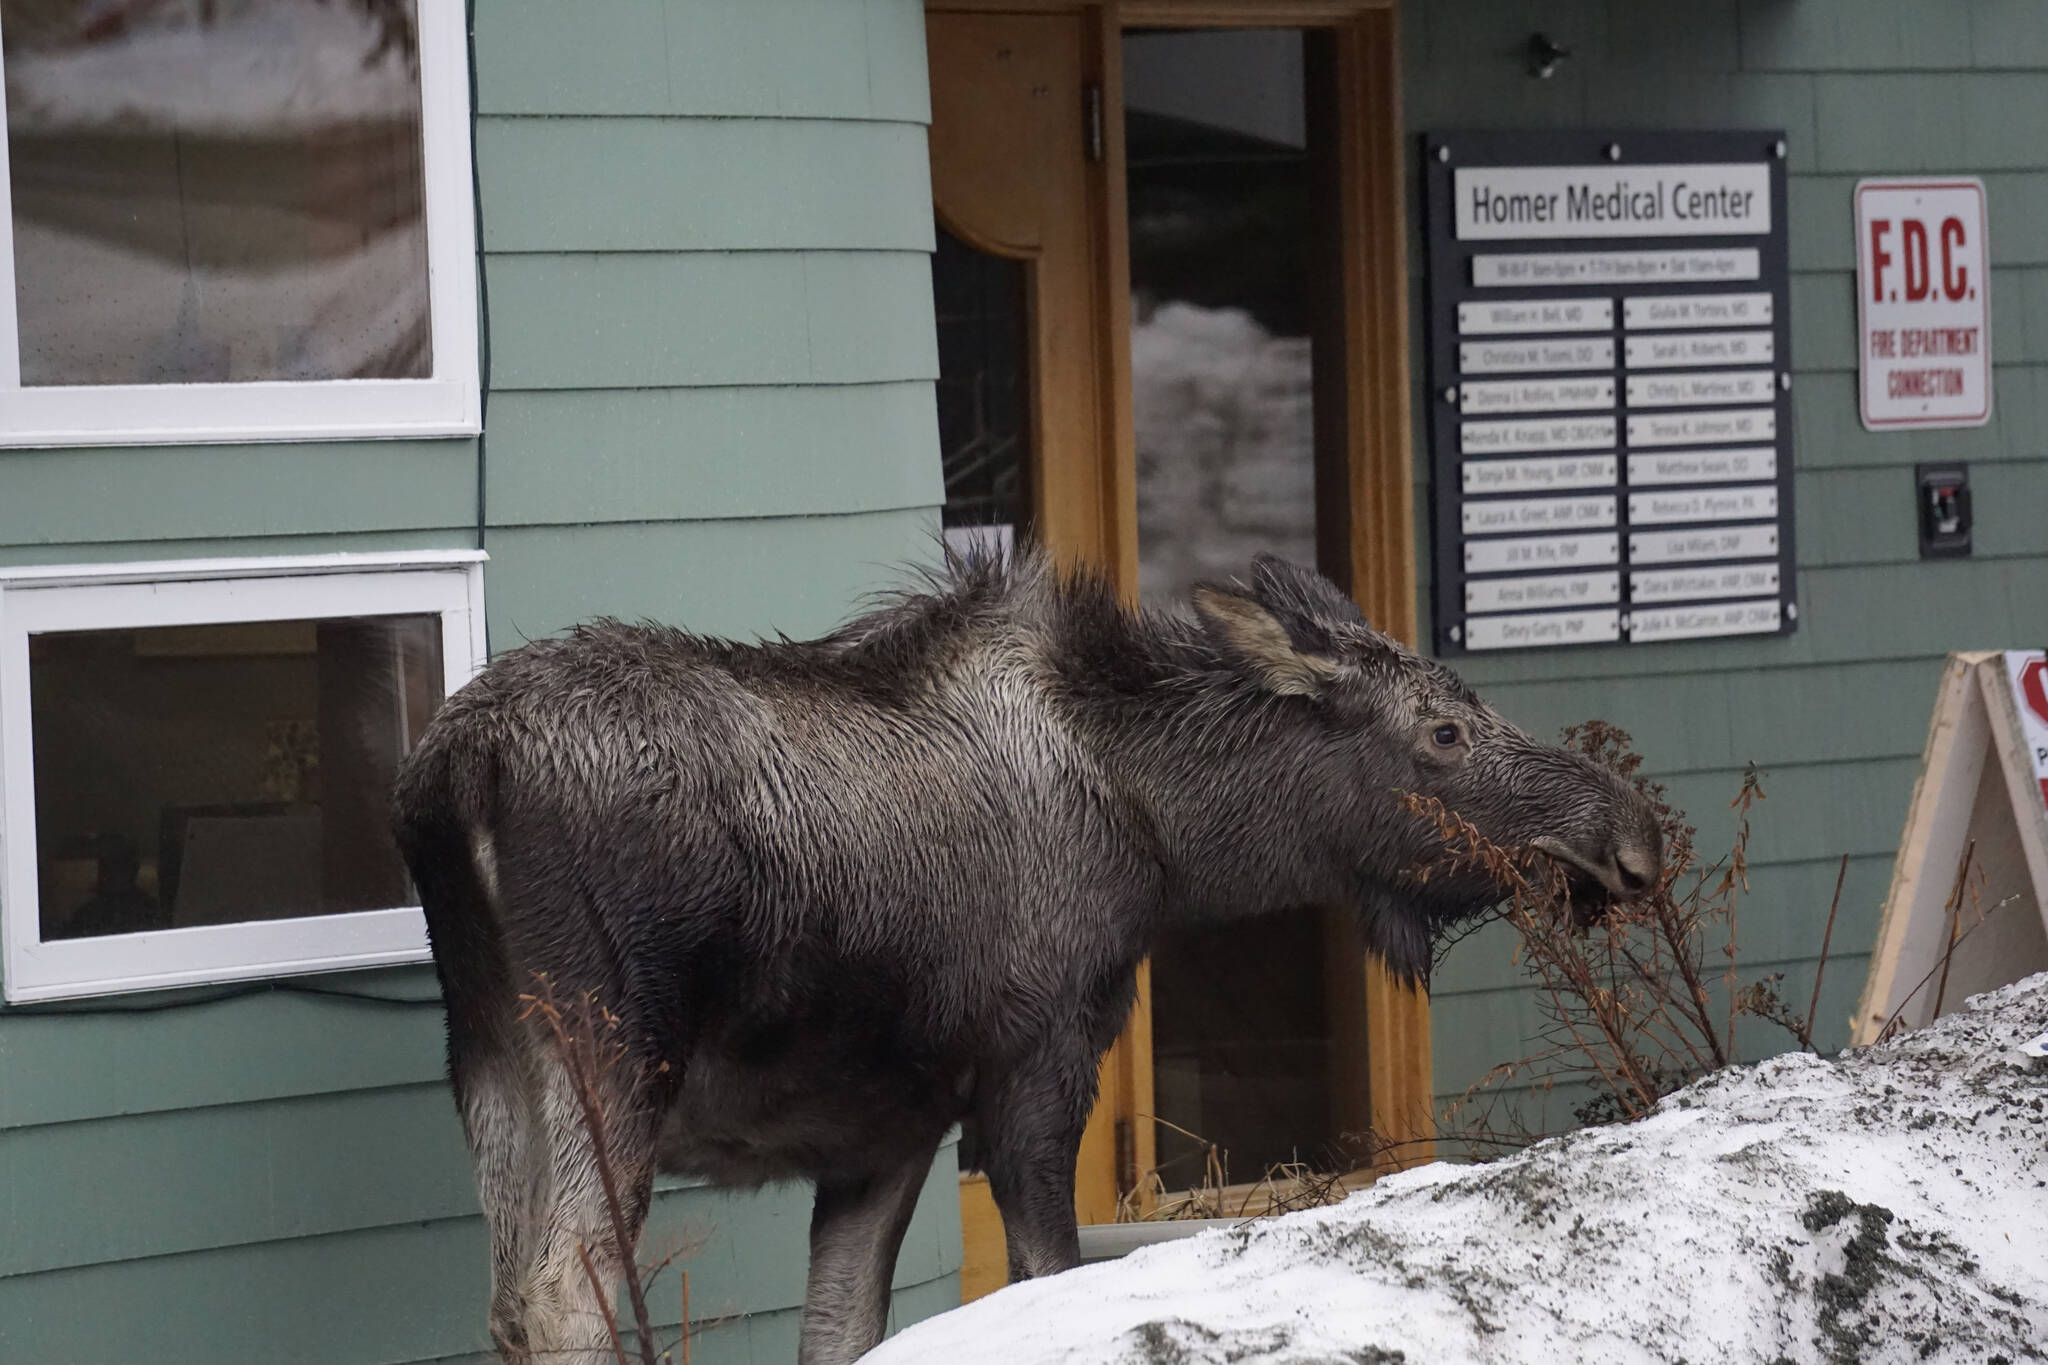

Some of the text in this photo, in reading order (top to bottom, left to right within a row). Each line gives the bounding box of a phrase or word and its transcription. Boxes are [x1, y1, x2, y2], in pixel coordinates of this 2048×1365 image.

[1472, 181, 1753, 224] Homer Medical Center
[1870, 217, 1975, 303] F.D.C.
[1871, 327, 1978, 359] FIRE DEPARTMENT
[1888, 369, 1964, 399] CONNECTION
